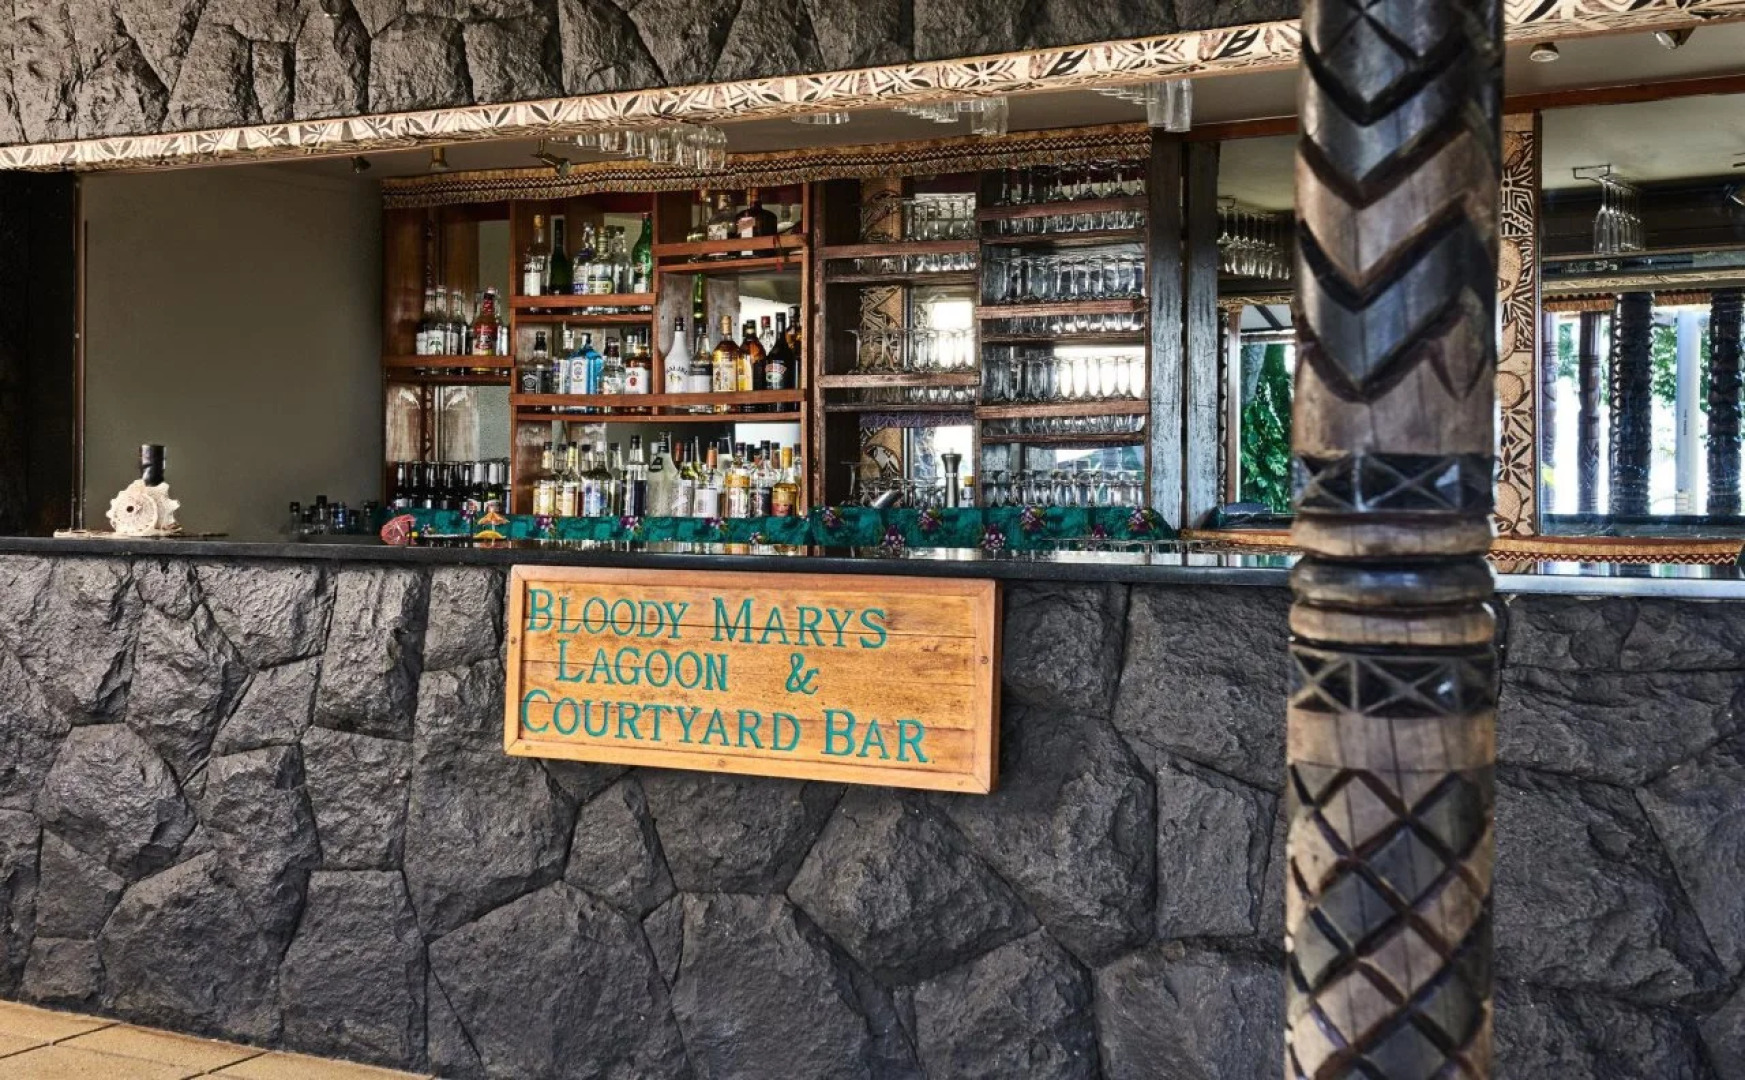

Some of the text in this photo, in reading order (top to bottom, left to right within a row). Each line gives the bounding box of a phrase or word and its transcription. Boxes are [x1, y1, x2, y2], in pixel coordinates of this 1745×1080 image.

[526, 588, 888, 650] BLOODY MARYS
[556, 640, 819, 695] LAGOON &
[521, 689, 929, 764] COURTYARD BAR
